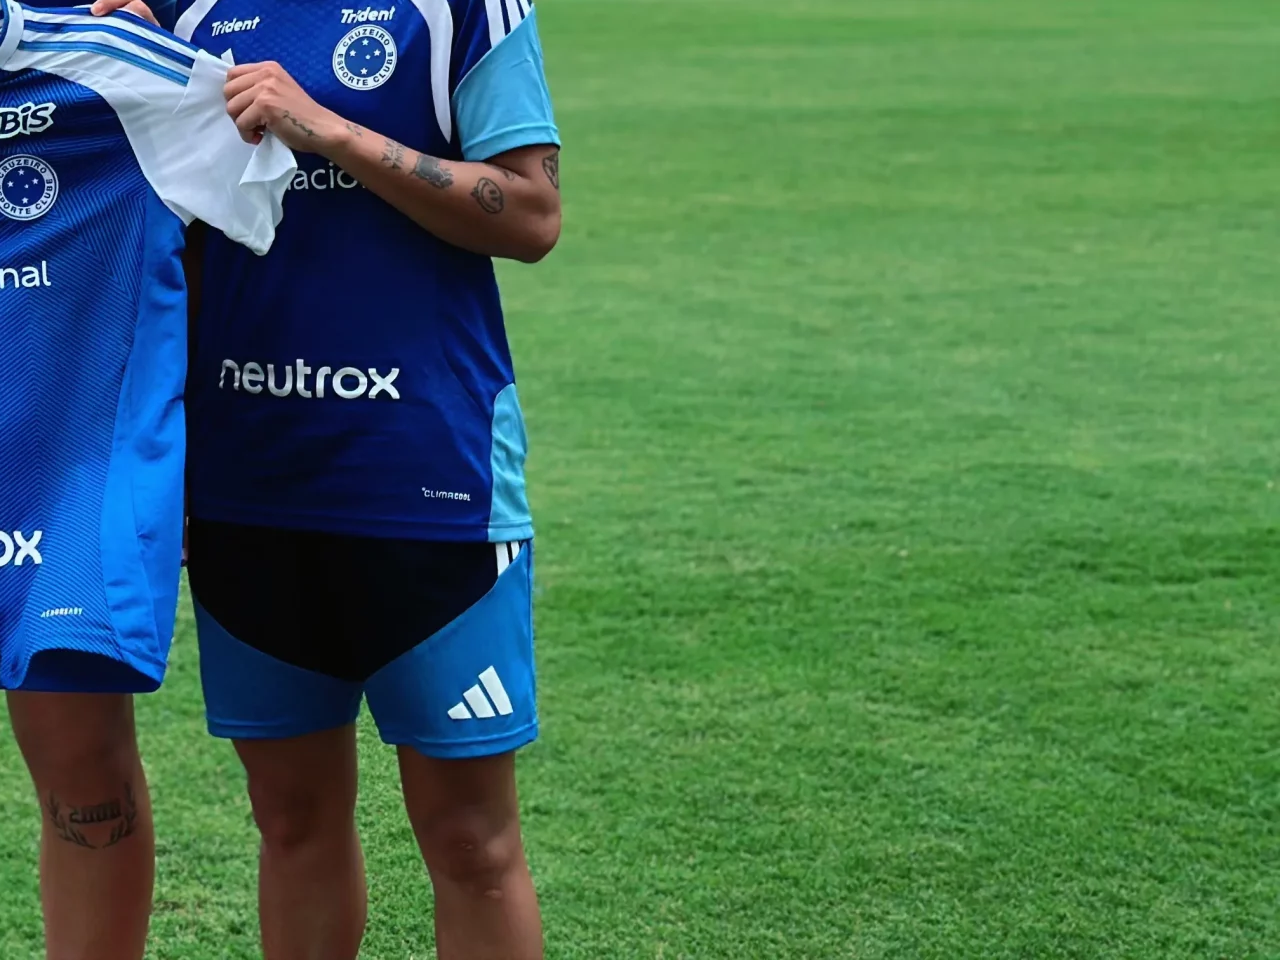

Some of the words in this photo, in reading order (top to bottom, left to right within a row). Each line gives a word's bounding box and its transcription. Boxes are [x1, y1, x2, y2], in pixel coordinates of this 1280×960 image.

[212, 16, 260, 37] Trident
[341, 6, 396, 24] Trident
[342, 28, 390, 48] CRUZEIRO
[337, 53, 368, 86] ESPORTE
[372, 51, 394, 83] CLUBE
[35, 178, 53, 210] CLUBE
[218, 358, 401, 400] neutrox
